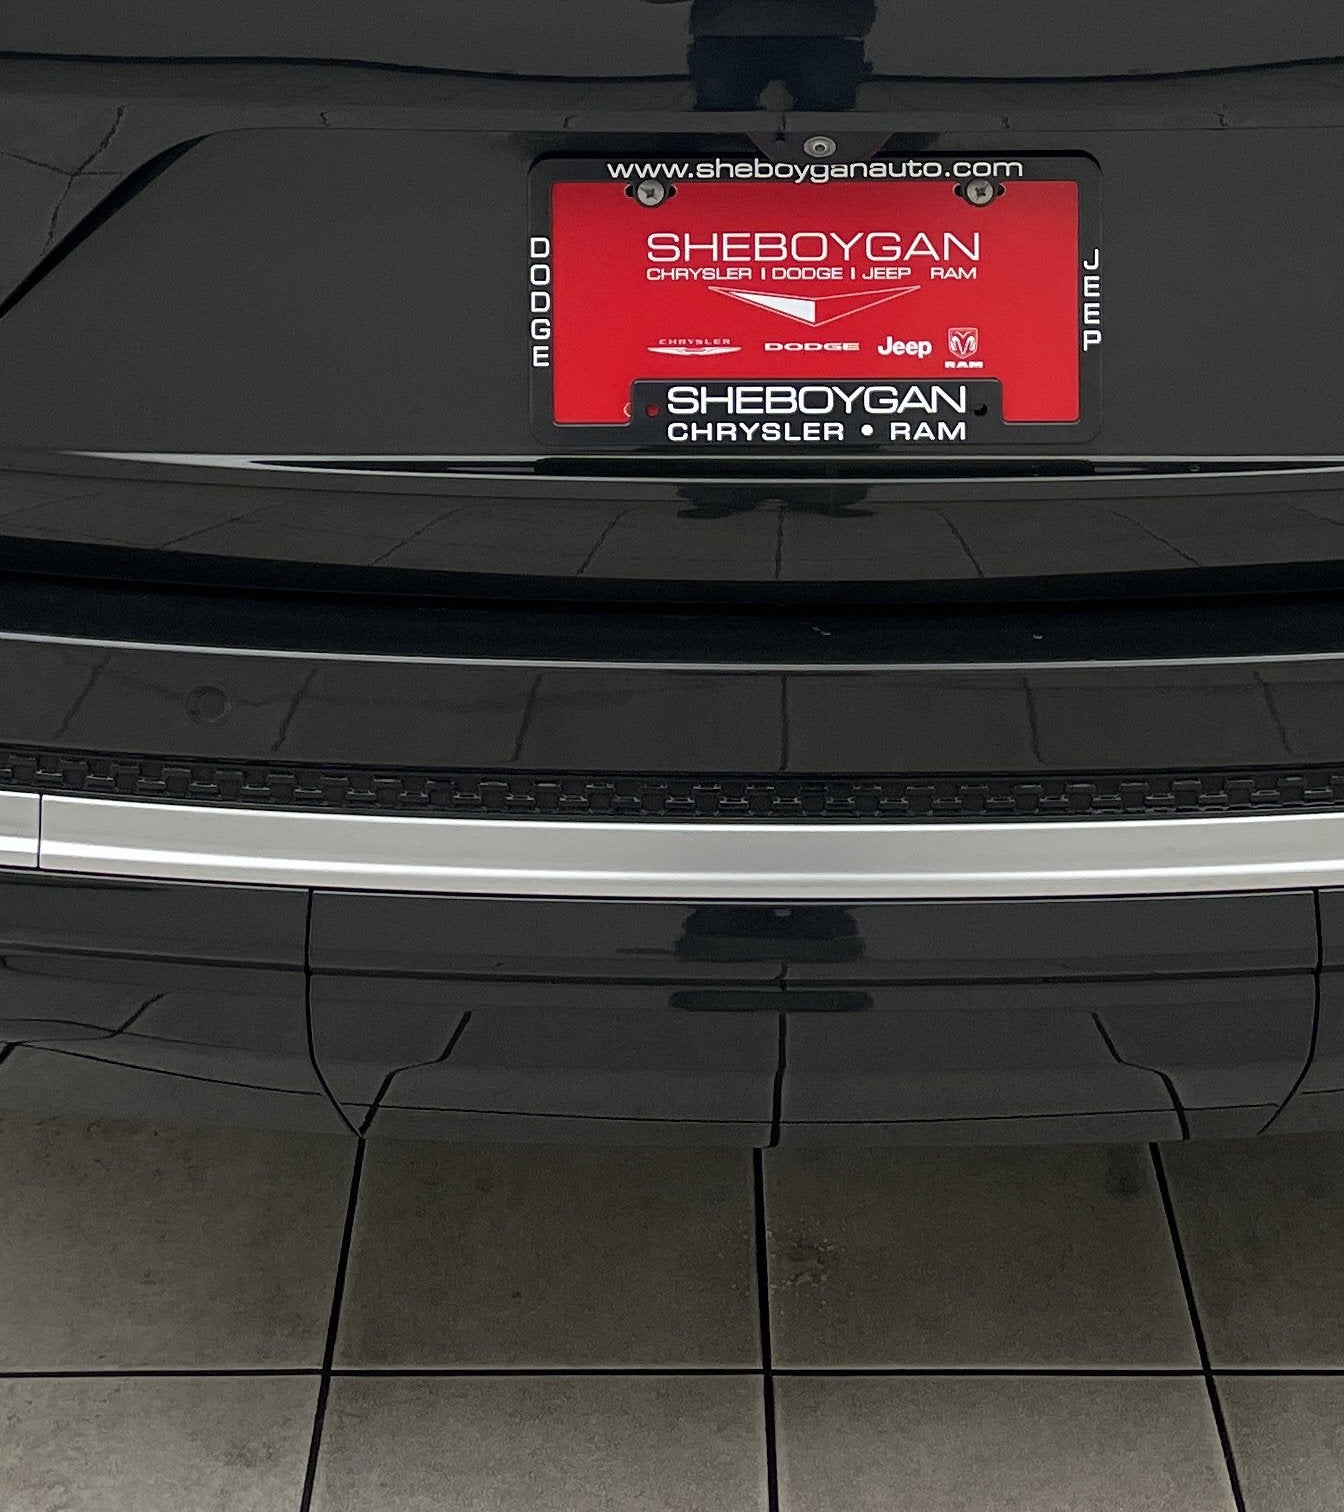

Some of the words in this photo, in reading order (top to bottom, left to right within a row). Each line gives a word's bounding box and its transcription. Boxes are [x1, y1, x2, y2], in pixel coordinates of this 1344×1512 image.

[606, 157, 1023, 184] www.sheboyganauto.com
[647, 231, 980, 262] SHEBOYGAN
[646, 267, 752, 281] CHRYSLER
[771, 266, 844, 280] DODGE
[861, 266, 912, 280] JEEP
[930, 266, 977, 280] RAM
[530, 237, 551, 368] DODGE
[1083, 248, 1102, 352] JEEP
[658, 337, 732, 346] CHRYSLER
[764, 342, 860, 351] DODGE
[877, 335, 933, 359] Jeep
[944, 360, 984, 369] RAM
[667, 385, 966, 415] SHEBOYGAN
[667, 422, 844, 442] CHRYSLER
[890, 421, 966, 441] RAM
